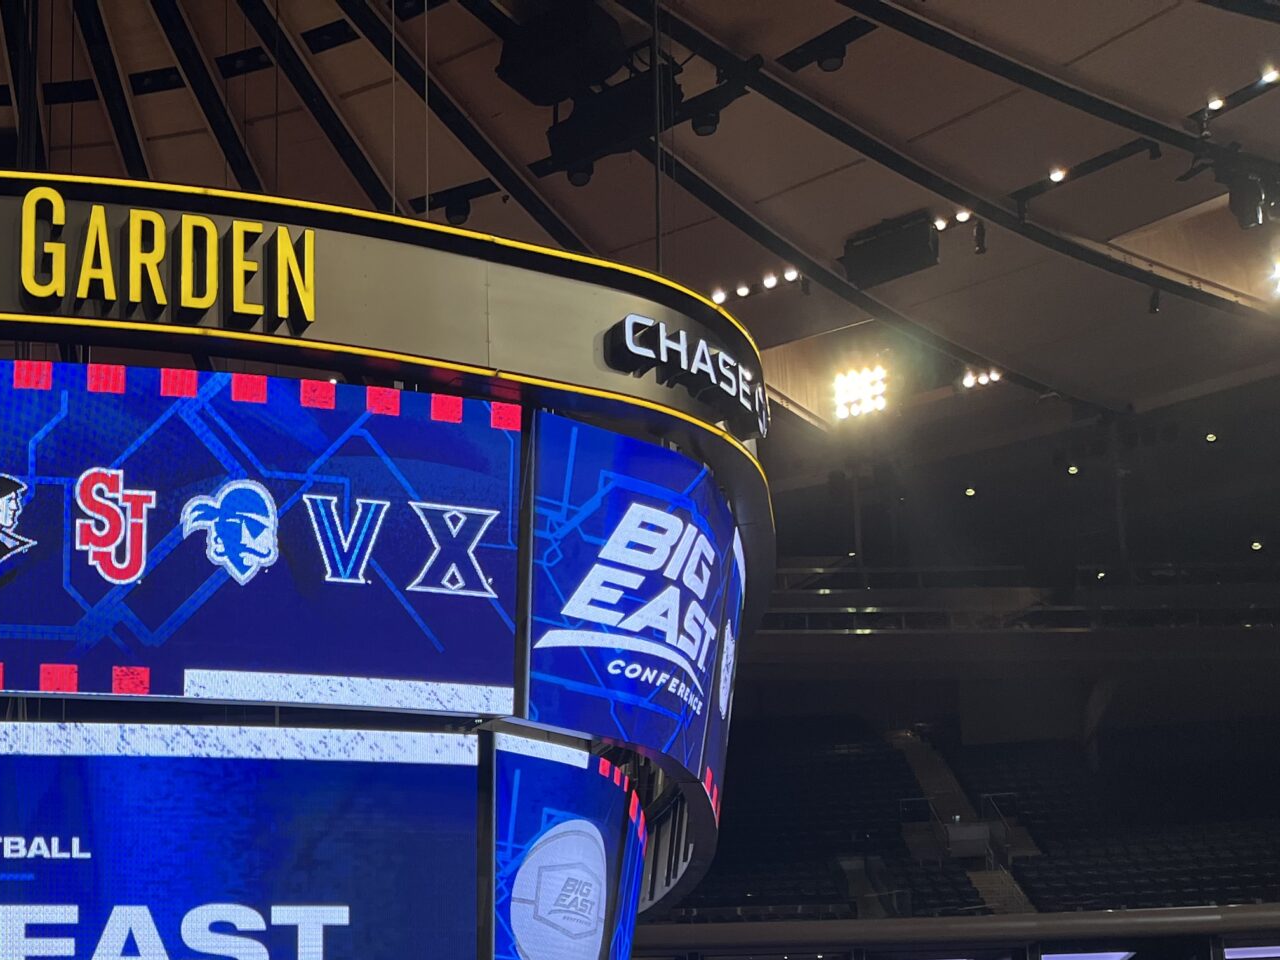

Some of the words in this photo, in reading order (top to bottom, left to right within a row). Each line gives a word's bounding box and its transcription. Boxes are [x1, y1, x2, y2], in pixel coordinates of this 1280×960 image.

[21, 186, 315, 322] GARDEN
[624, 313, 752, 412] CHASE
[303, 494, 391, 584] V
[406, 500, 500, 598] X
[598, 502, 716, 600] BIG
[561, 563, 718, 672] EAST
[607, 659, 704, 716] CONFERENCE
[553, 893, 595, 915] EAST
[562, 877, 593, 897] BIG
